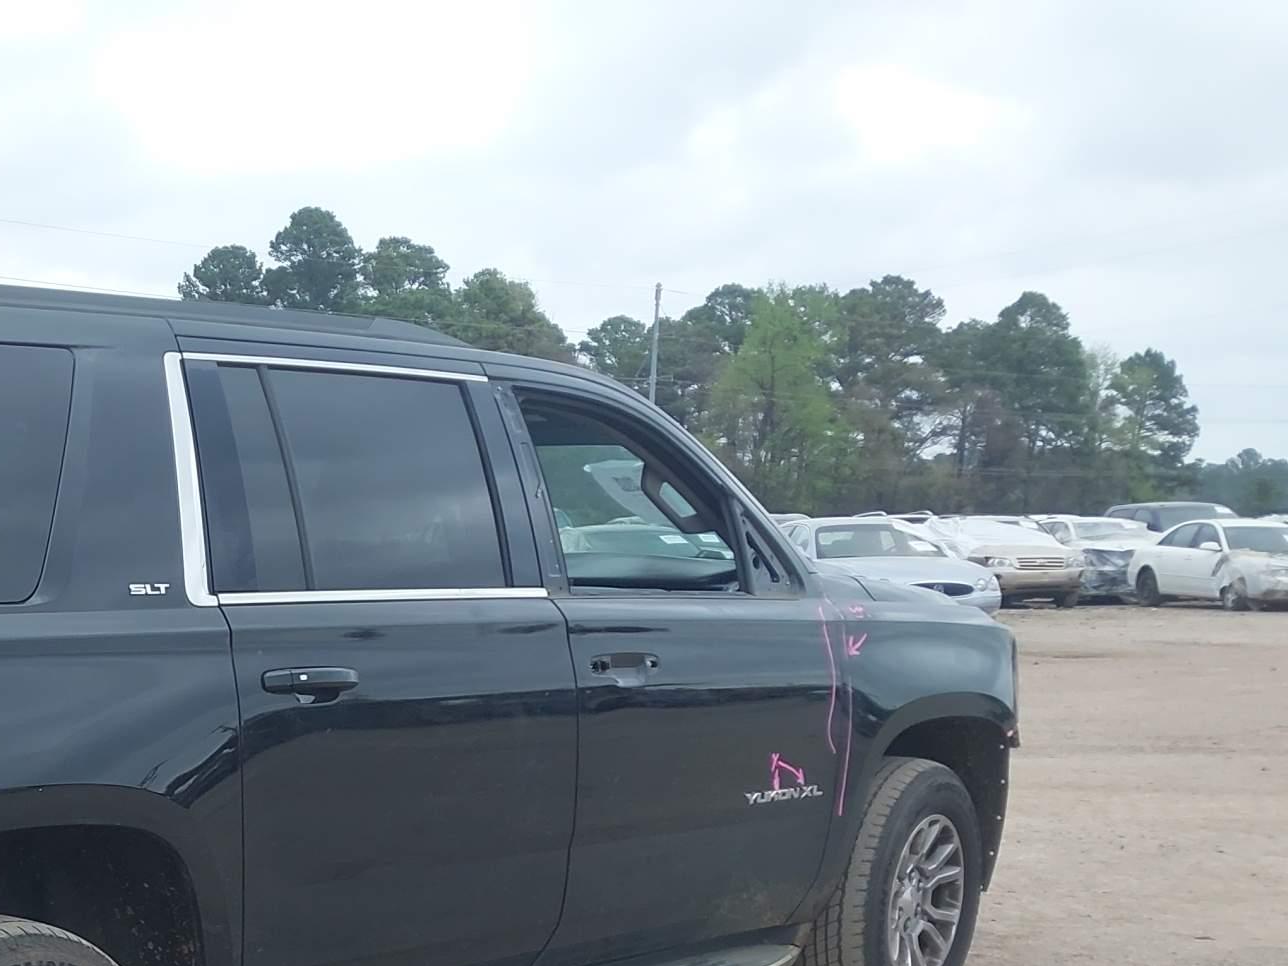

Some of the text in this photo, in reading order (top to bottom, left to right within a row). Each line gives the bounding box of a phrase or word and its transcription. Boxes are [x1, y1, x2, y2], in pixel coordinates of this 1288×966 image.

[129, 583, 170, 595] SLT
[745, 785, 823, 804] YUKON XL
